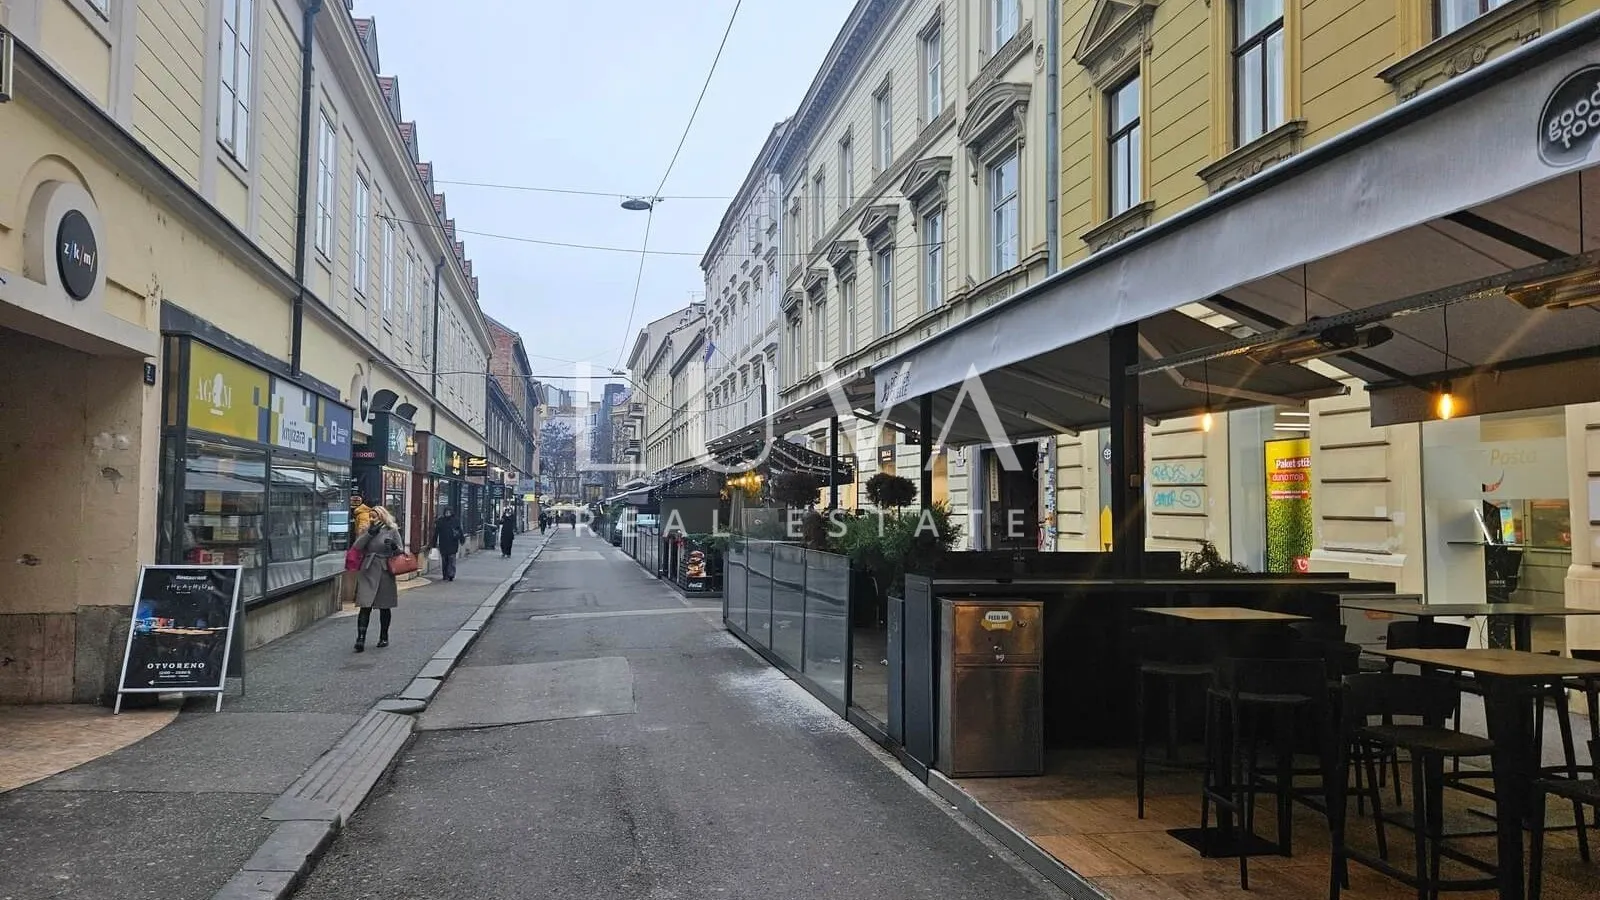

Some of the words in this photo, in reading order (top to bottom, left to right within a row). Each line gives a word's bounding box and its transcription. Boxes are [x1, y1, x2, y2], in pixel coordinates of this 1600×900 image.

[1561, 110, 1600, 149] foo
[1275, 458, 1296, 469] Paket
[1297, 457, 1312, 468] stiž
